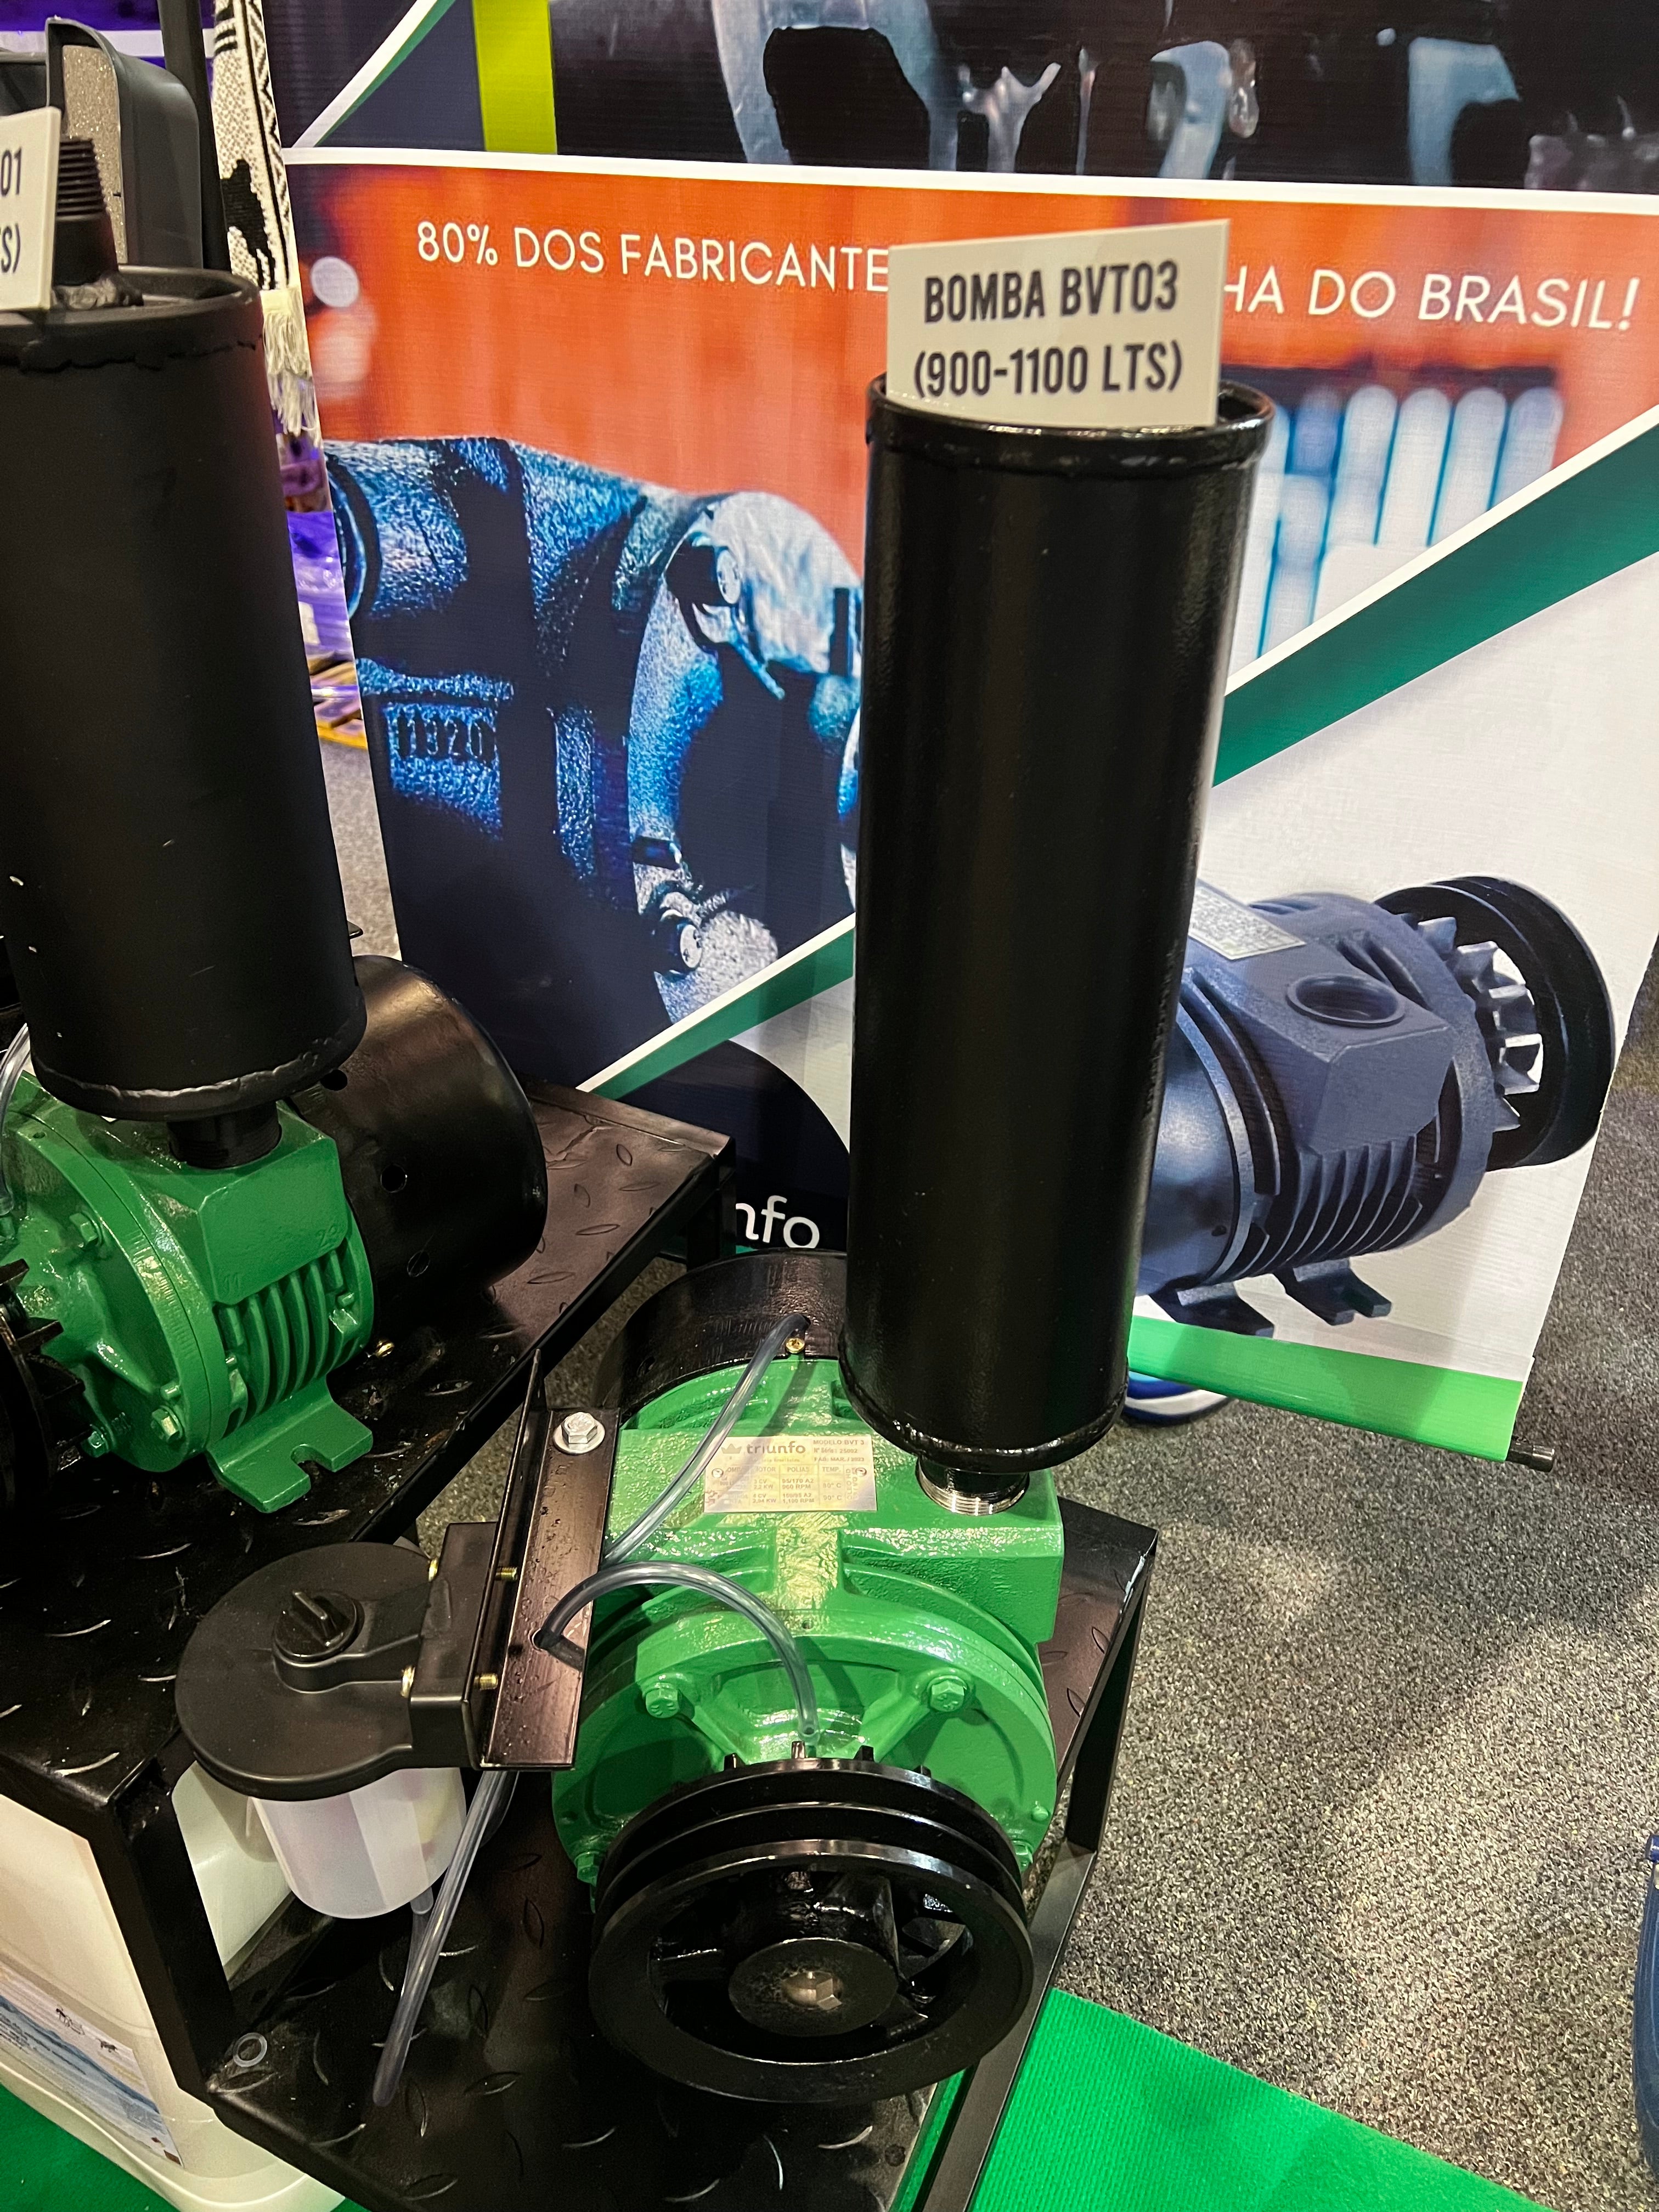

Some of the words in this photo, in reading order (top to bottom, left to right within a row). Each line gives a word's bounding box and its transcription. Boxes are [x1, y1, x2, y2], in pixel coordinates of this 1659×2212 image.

[417, 221, 498, 266] 80%
[514, 227, 604, 273] DOS
[620, 233, 888, 292] FABRICANTE
[1308, 269, 1396, 318] DO
[1418, 274, 1640, 330] BRASIL!
[924, 270, 1045, 324] BOMBA
[1060, 259, 1179, 317] BVT03
[915, 345, 1088, 398] (900-1100
[1102, 339, 1183, 393] LTS)
[747, 1441, 806, 1454] triunfo
